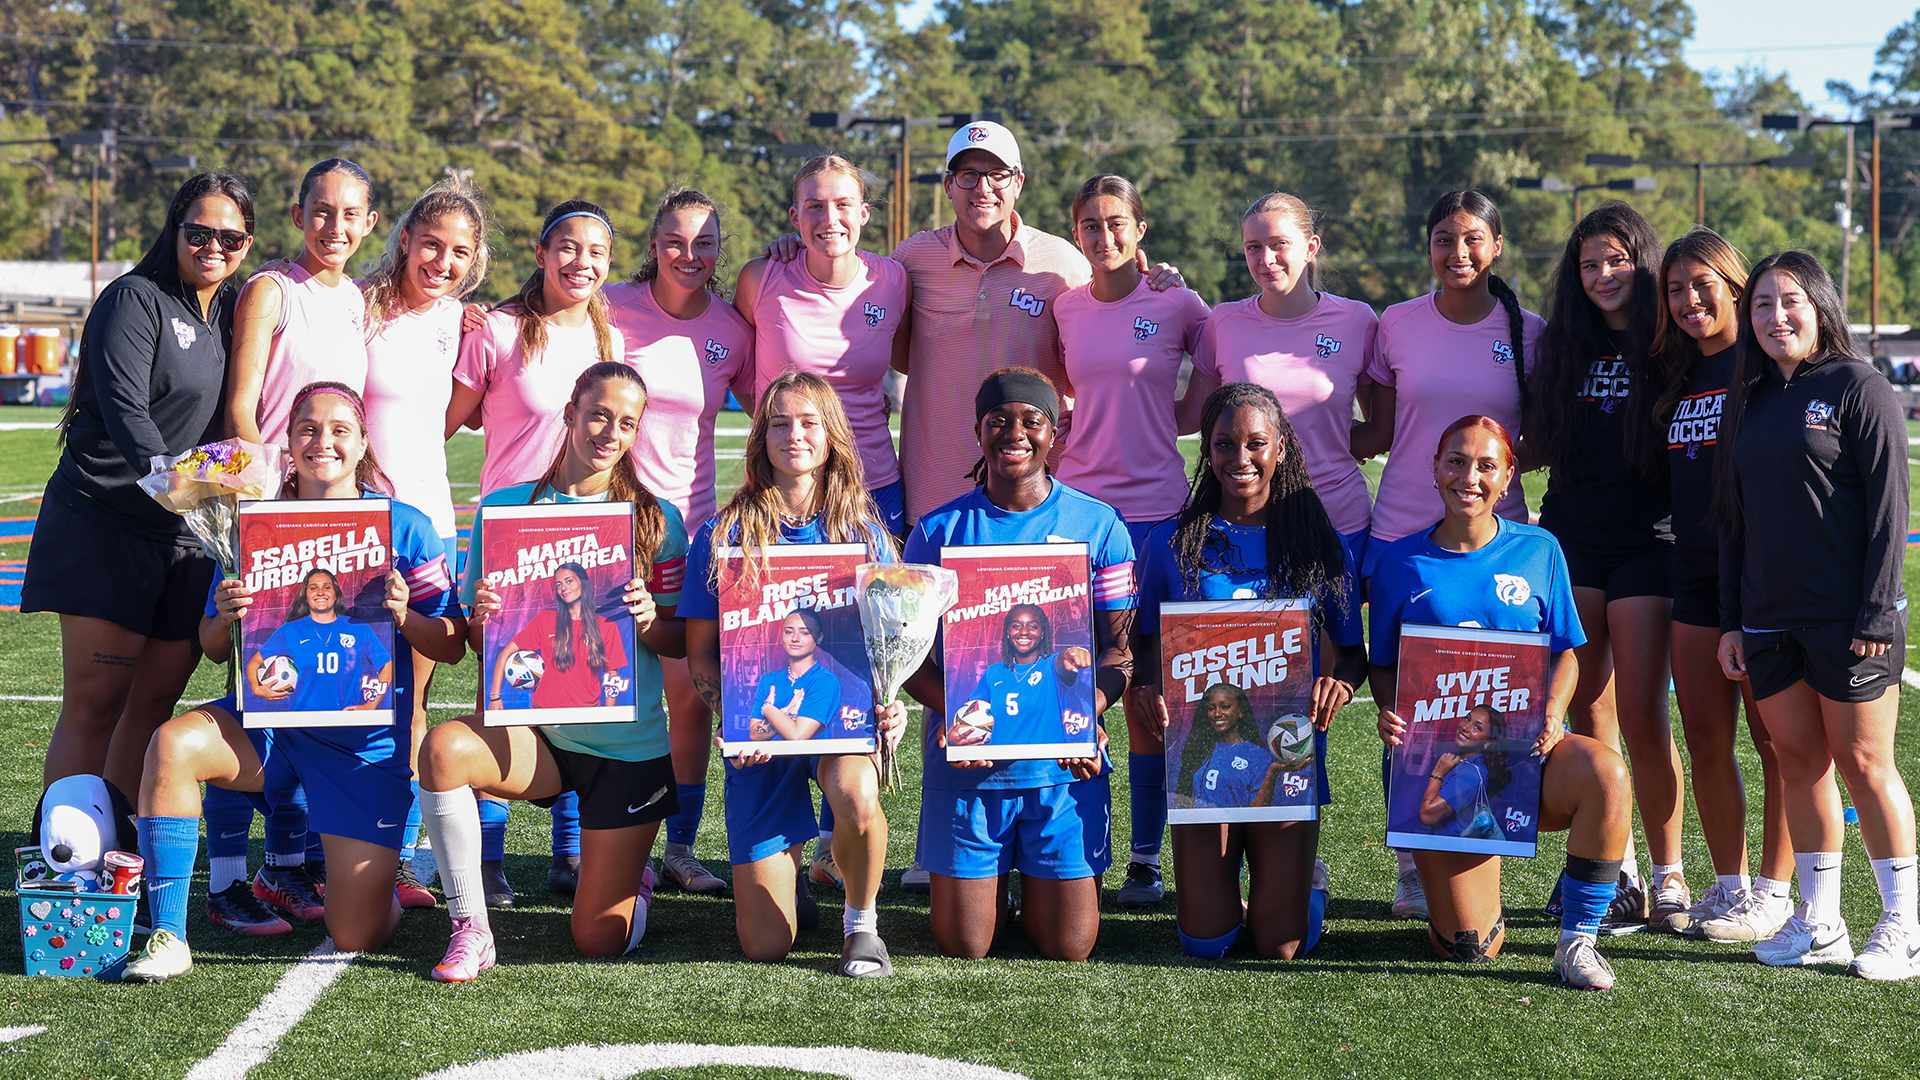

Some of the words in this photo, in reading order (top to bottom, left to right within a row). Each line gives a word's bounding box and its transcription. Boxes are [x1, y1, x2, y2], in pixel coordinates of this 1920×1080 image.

[864, 302, 886, 320] LCU
[1010, 288, 1046, 317] LCU
[1134, 316, 1159, 335] LCU
[705, 339, 730, 360] LCU
[1315, 333, 1342, 353] LCU
[1492, 340, 1515, 360] LCU
[1673, 394, 1727, 421] ILDCA
[1807, 399, 1834, 419] LCU
[1667, 416, 1721, 444] OCCE
[251, 525, 381, 573] ISABELLA
[517, 533, 600, 567] MARTA
[244, 544, 386, 594] URBANETO
[762, 572, 829, 604] ROSE
[984, 575, 1051, 603] KAMSI
[946, 582, 1088, 624] NWOSU-DAMIAN
[316, 652, 339, 674] 10
[1171, 627, 1302, 680] GISELLE
[361, 674, 388, 695] LCU
[603, 672, 630, 692] LCU
[1184, 656, 1288, 703] LAING
[1436, 666, 1511, 696] YVIE
[841, 705, 868, 725] LCU
[1006, 692, 1019, 716] 5
[1062, 709, 1090, 729] LCU
[1205, 769, 1219, 791] 9
[1282, 771, 1309, 791] LCU
[1505, 806, 1531, 827] LCU
